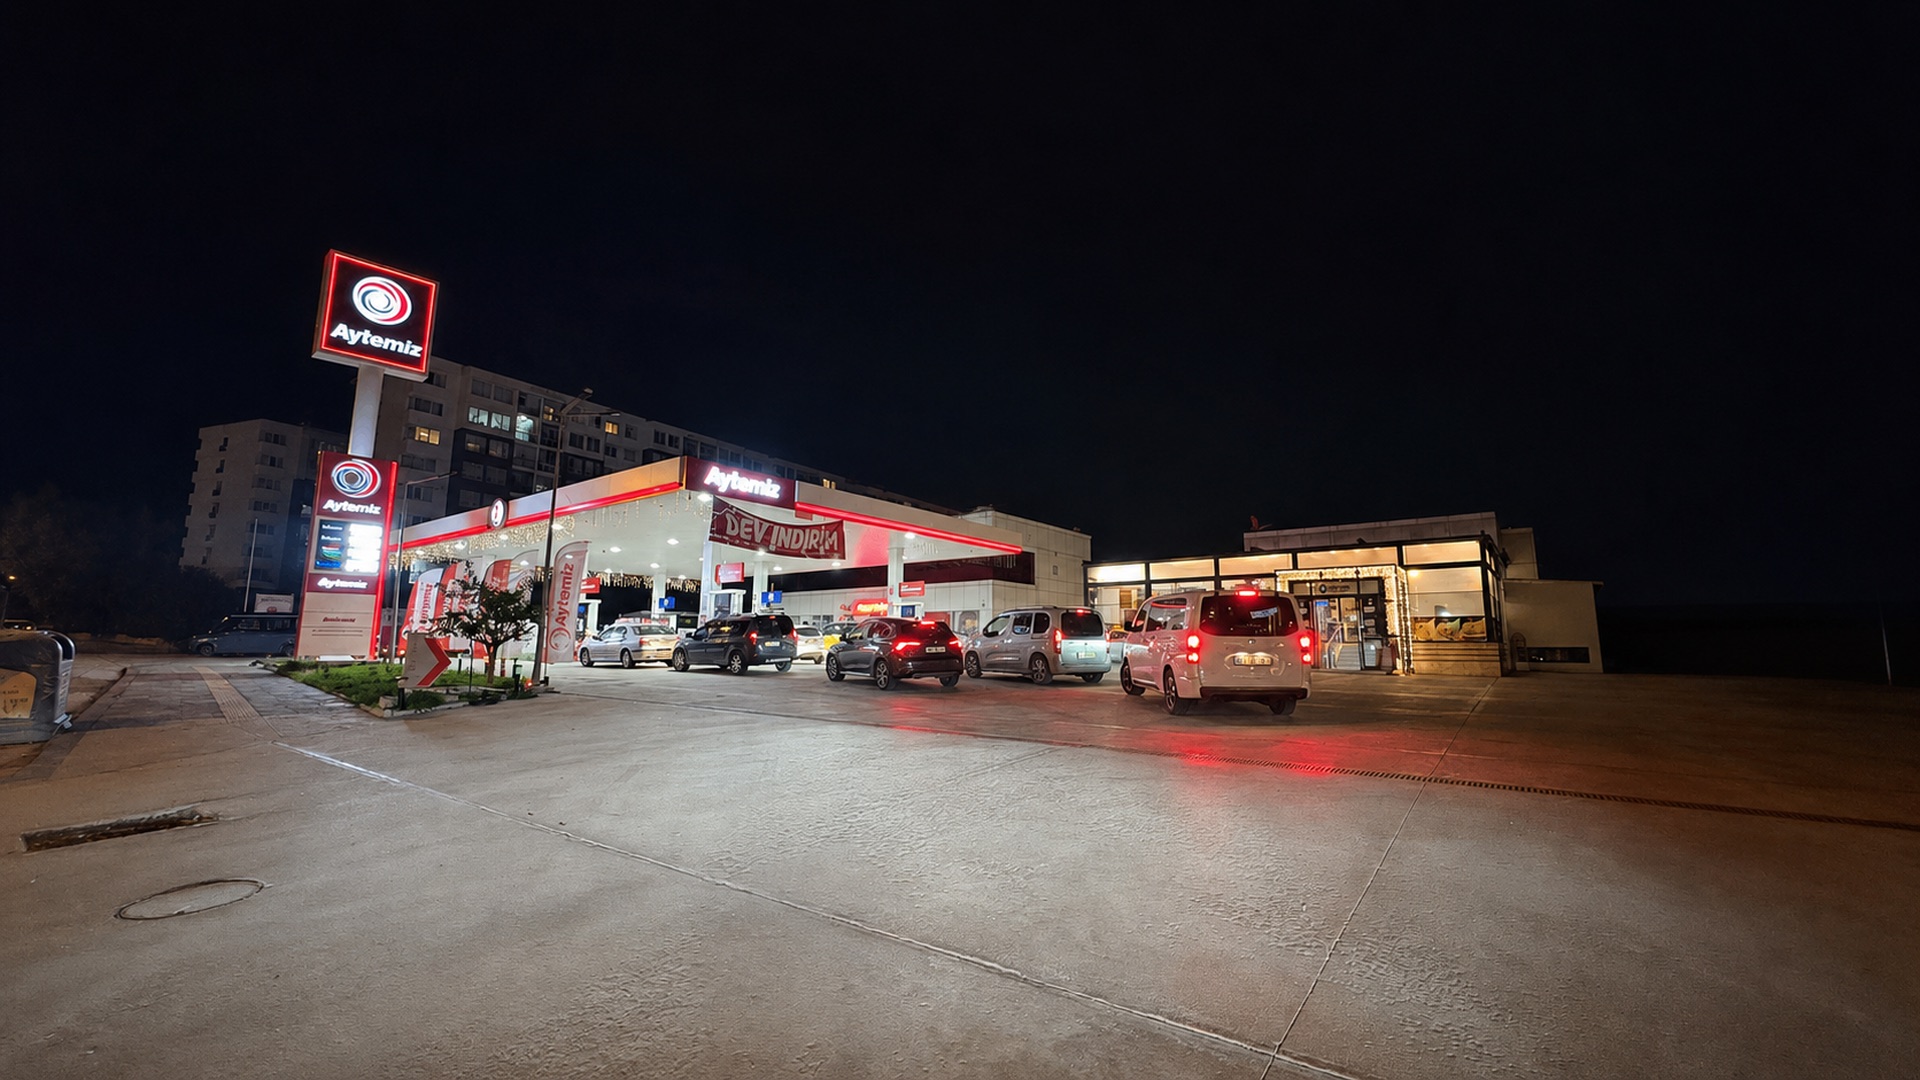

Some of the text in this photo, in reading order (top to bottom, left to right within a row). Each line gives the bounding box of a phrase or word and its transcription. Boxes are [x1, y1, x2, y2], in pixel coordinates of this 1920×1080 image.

[330, 323, 423, 357] Aytemiz
[703, 465, 781, 499] Aytemiz
[322, 499, 382, 515] Aytemiz
[725, 512, 767, 543] DEV
[554, 562, 575, 627] Aytemiz
